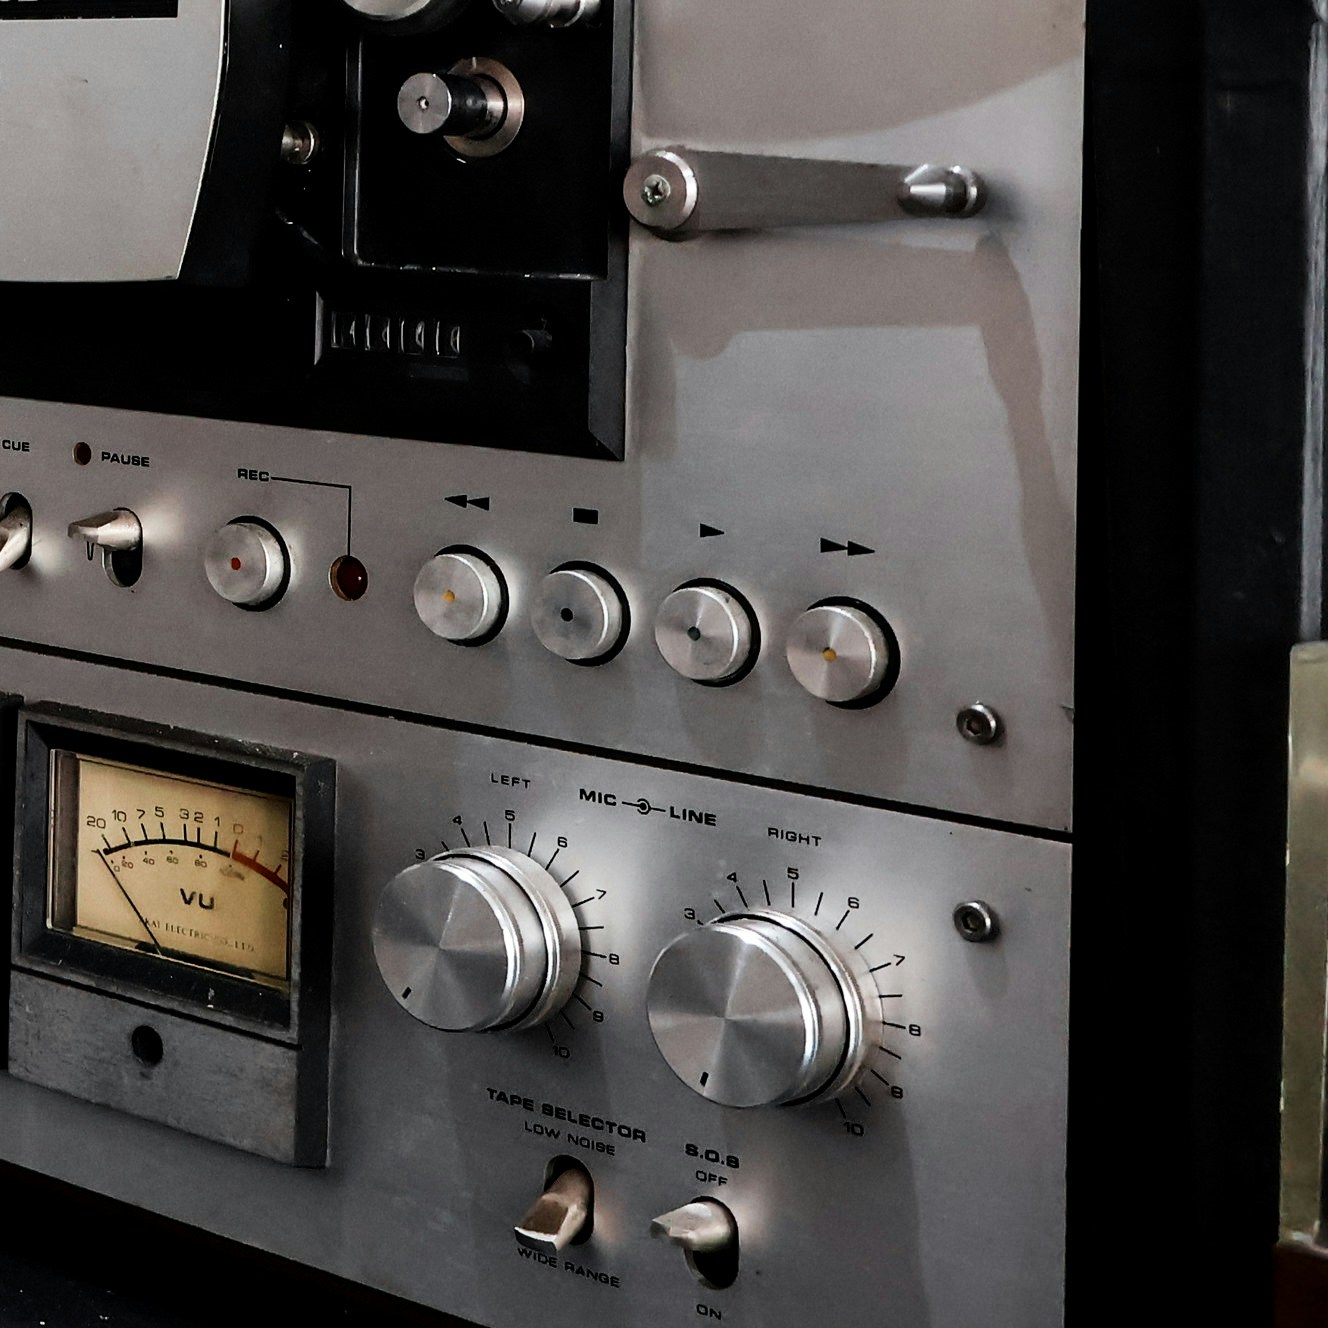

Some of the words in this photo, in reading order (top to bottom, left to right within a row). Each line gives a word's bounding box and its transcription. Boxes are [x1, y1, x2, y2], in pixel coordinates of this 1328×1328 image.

[2, 439, 30, 452] CUE
[101, 451, 150, 468] PAUSE
[237, 468, 270, 482] REC
[490, 772, 531, 789] LEFT
[579, 788, 618, 807] MIC
[669, 806, 717, 827] LINE
[87, 815, 106, 829] 20
[112, 809, 127, 823] 10
[136, 809, 146, 820] 7
[154, 806, 164, 818] 5
[179, 808, 189, 820] 3
[194, 812, 204, 823] 2
[214, 817, 220, 827] 1
[233, 823, 243, 836] 0
[452, 815, 463, 826] 4
[504, 809, 515, 822] 5
[556, 836, 568, 849] 6
[767, 827, 822, 848] RIGHT
[142, 857, 155, 866] 40
[414, 848, 426, 862] 3
[726, 872, 738, 883] 4
[787, 867, 799, 882] 5
[180, 888, 214, 910] VU
[595, 889, 608, 903] 7
[847, 897, 860, 910] 6
[683, 908, 697, 922] 3
[608, 953, 620, 966] 8
[892, 955, 906, 968] 7
[592, 1009, 604, 1023] 9
[908, 1023, 921, 1037] 8
[552, 1045, 571, 1060] 10
[487, 1087, 535, 1112] TAPE
[541, 1104, 647, 1144] SELECTOR
[845, 1122, 865, 1137] 10
[524, 1121, 560, 1140] LOW
[567, 1133, 616, 1157] NOISE
[695, 1170, 728, 1187] OFF
[517, 1246, 557, 1269] WIDE
[564, 1261, 621, 1288] RANGE
[696, 1303, 722, 1321] ON
